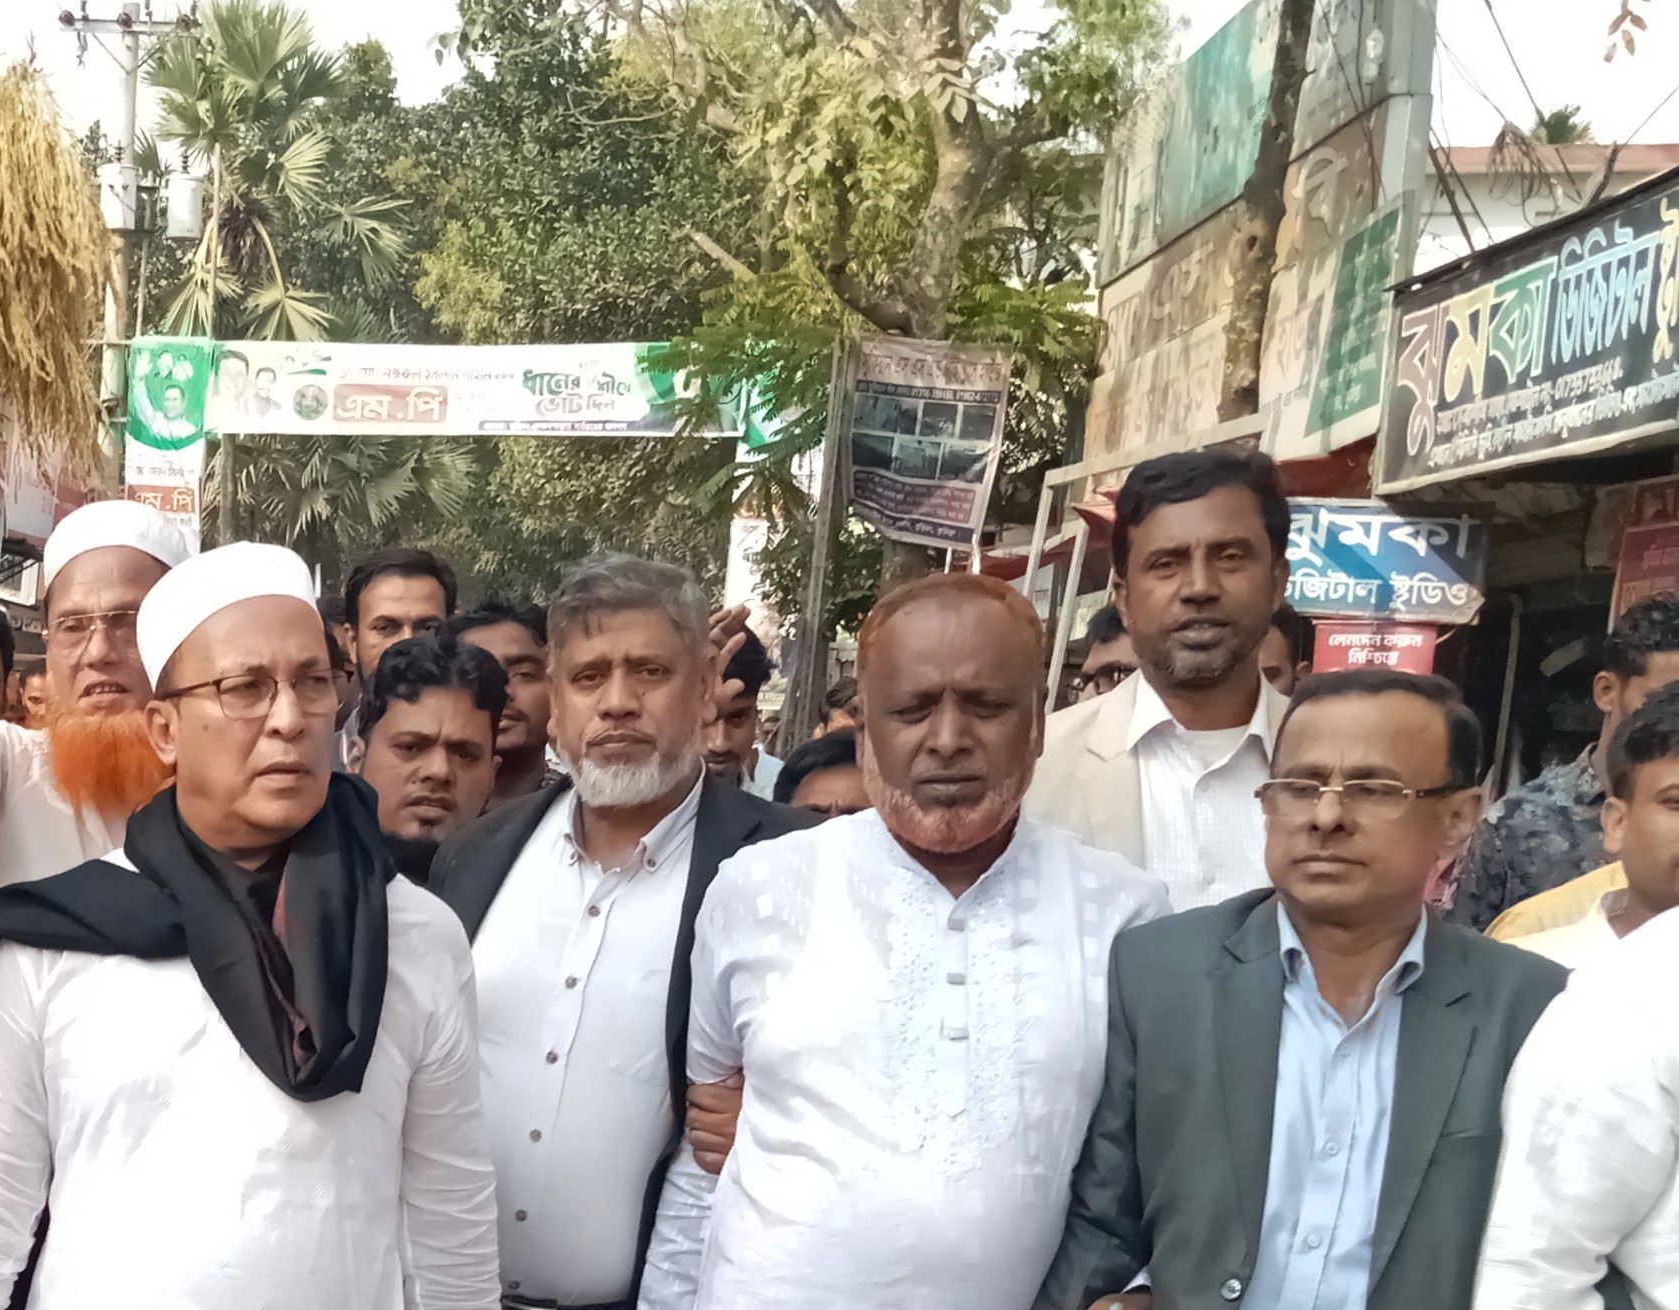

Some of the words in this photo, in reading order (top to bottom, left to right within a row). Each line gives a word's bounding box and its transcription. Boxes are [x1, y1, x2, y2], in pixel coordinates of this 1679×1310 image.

[1397, 255, 1559, 456] ঝুমকা
[1551, 219, 1661, 366] ডিজিটাল
[523, 369, 580, 396] ধানের
[1284, 507, 1482, 567] ঝুমকা
[1284, 568, 1382, 605] জিটাল
[1328, 633, 1381, 648] লেনদেন
